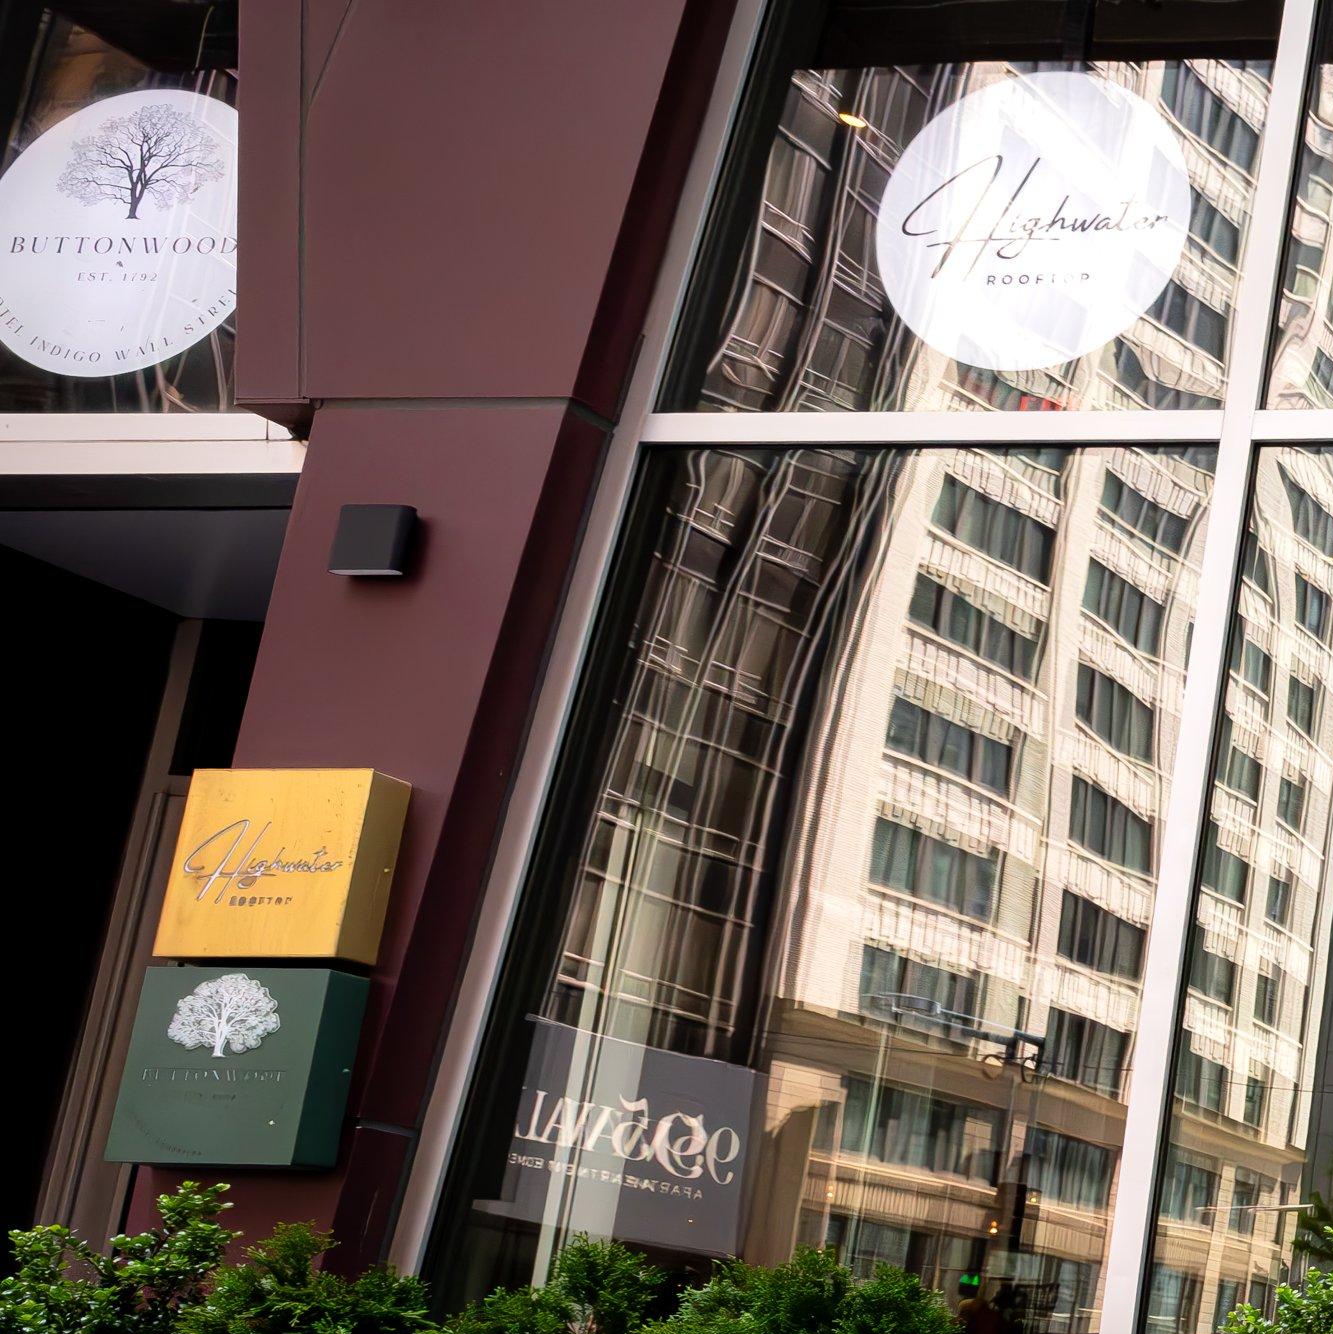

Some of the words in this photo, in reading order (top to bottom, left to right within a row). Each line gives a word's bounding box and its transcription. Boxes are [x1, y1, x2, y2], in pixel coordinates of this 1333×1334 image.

[901, 154, 1169, 281] Highwater
[10, 235, 237, 255] BUTTONWOOD
[77, 271, 112, 282] EST.
[122, 272, 158, 282] 1792
[986, 273, 1090, 286] ROOFTP
[29, 335, 101, 363] INDIGO
[114, 335, 174, 361] WALL
[183, 819, 343, 905] Highwater
